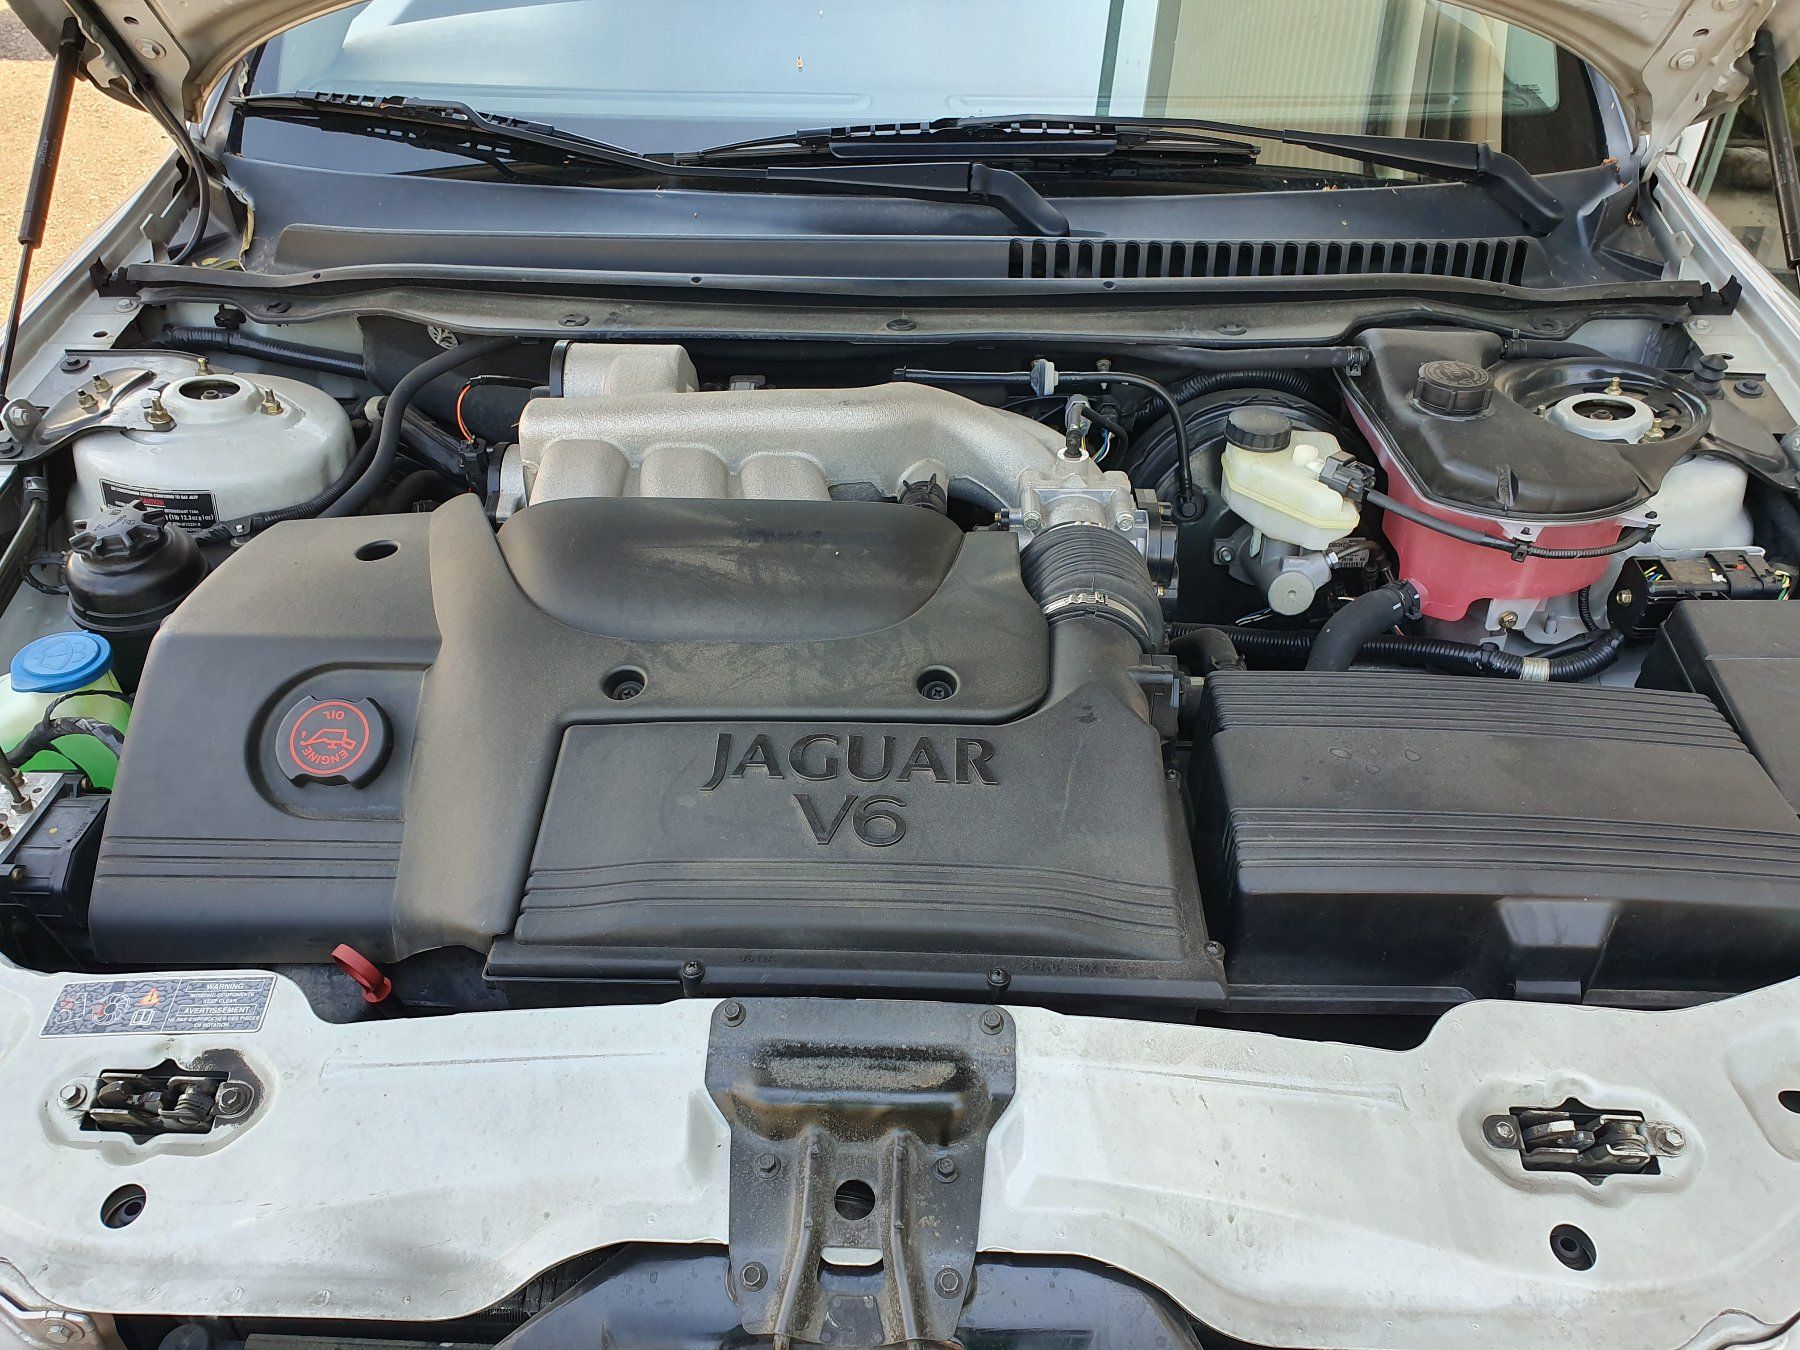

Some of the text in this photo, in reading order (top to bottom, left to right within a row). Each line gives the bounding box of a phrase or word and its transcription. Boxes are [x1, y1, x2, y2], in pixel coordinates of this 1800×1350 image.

[322, 709, 345, 720] OIL
[302, 745, 349, 765] ENGINE
[699, 732, 999, 792] JAGUAR
[792, 793, 907, 847] V6
[183, 1006, 251, 1014] AVERTISSEMENT
